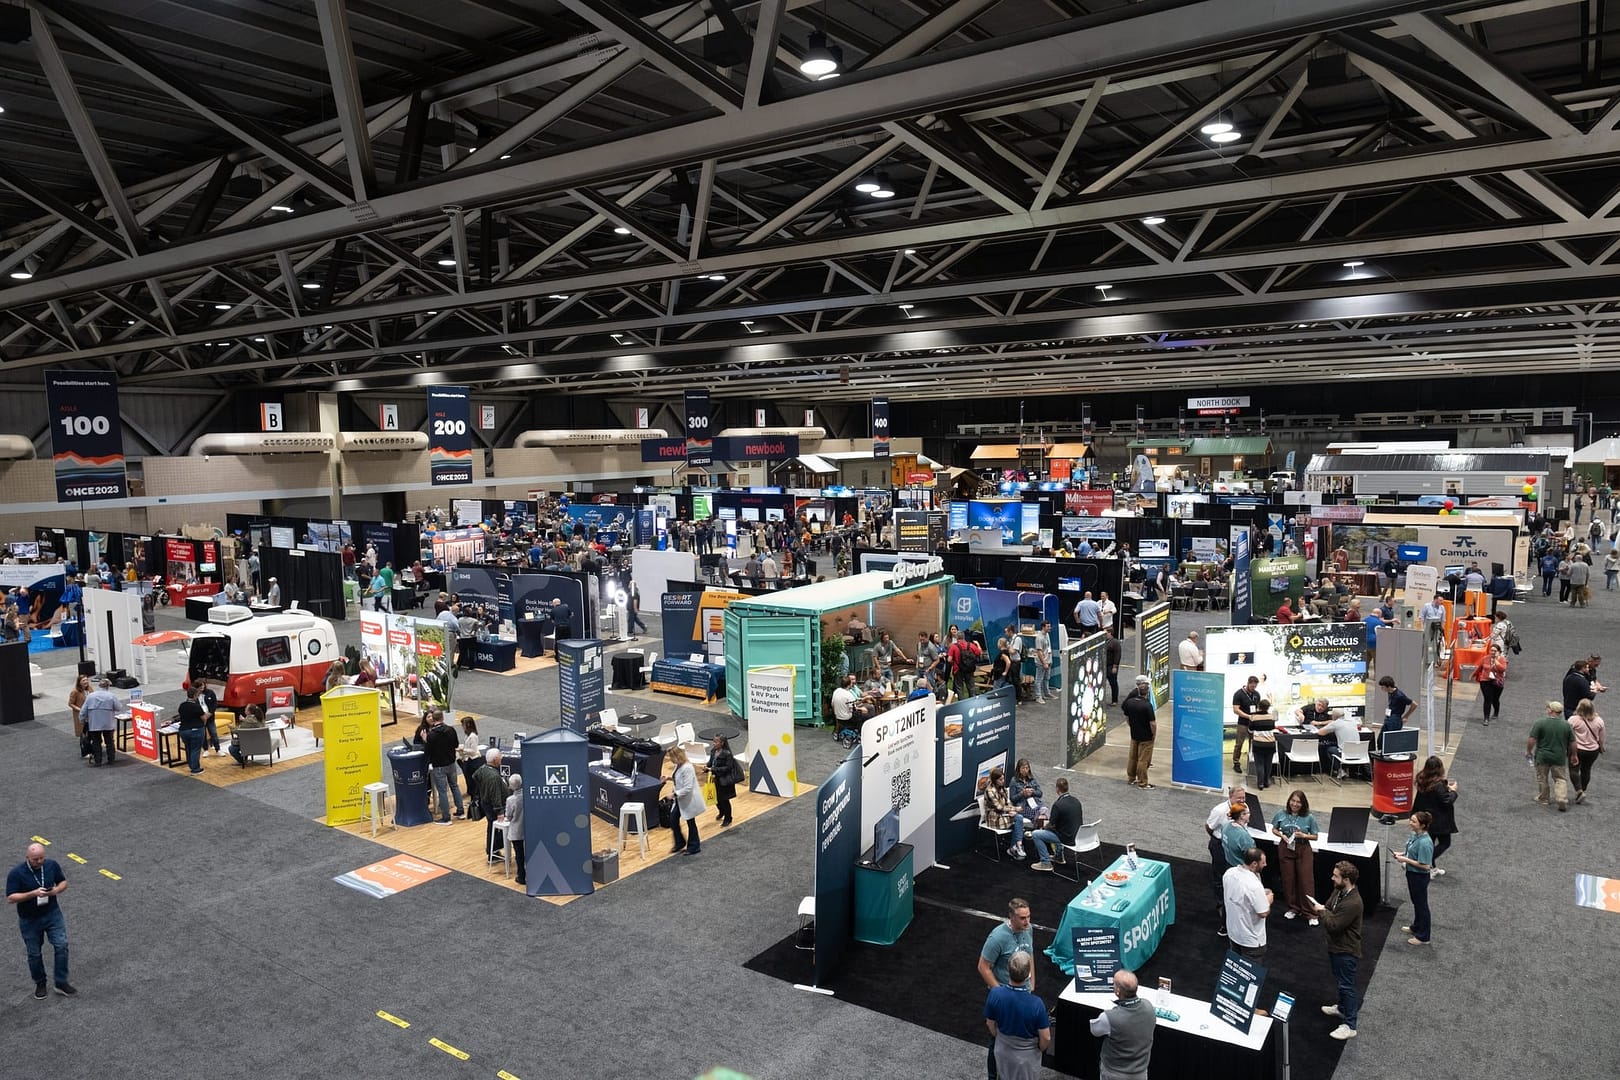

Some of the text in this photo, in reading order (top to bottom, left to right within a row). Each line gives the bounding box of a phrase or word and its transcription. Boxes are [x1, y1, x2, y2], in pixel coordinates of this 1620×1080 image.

[61, 416, 110, 435] 100
[269, 414, 278, 428] B
[387, 414, 395, 427] A
[688, 416, 708, 428] 300
[874, 418, 888, 428] 400
[434, 420, 466, 435] 200
[659, 443, 687, 456] newb
[745, 441, 785, 454] newbook
[1440, 549, 1488, 558] CampLife
[1303, 635, 1359, 647] ResNexus
[478, 652, 494, 662] RMS
[750, 683, 789, 692] Campground
[1180, 687, 1216, 695] INTRODUCING
[751, 698, 790, 708] Management
[751, 705, 779, 714] Software
[876, 707, 926, 743] SPOT2NITE
[530, 784, 583, 795] FIREFLY
[822, 779, 847, 815] Grow your
[821, 787, 851, 834] campground
[821, 825, 843, 853] revenue.
[897, 872, 907, 890] SPOT
[1123, 888, 1170, 953] SPOT2NITE
[1239, 966, 1257, 980] CONNECTED
